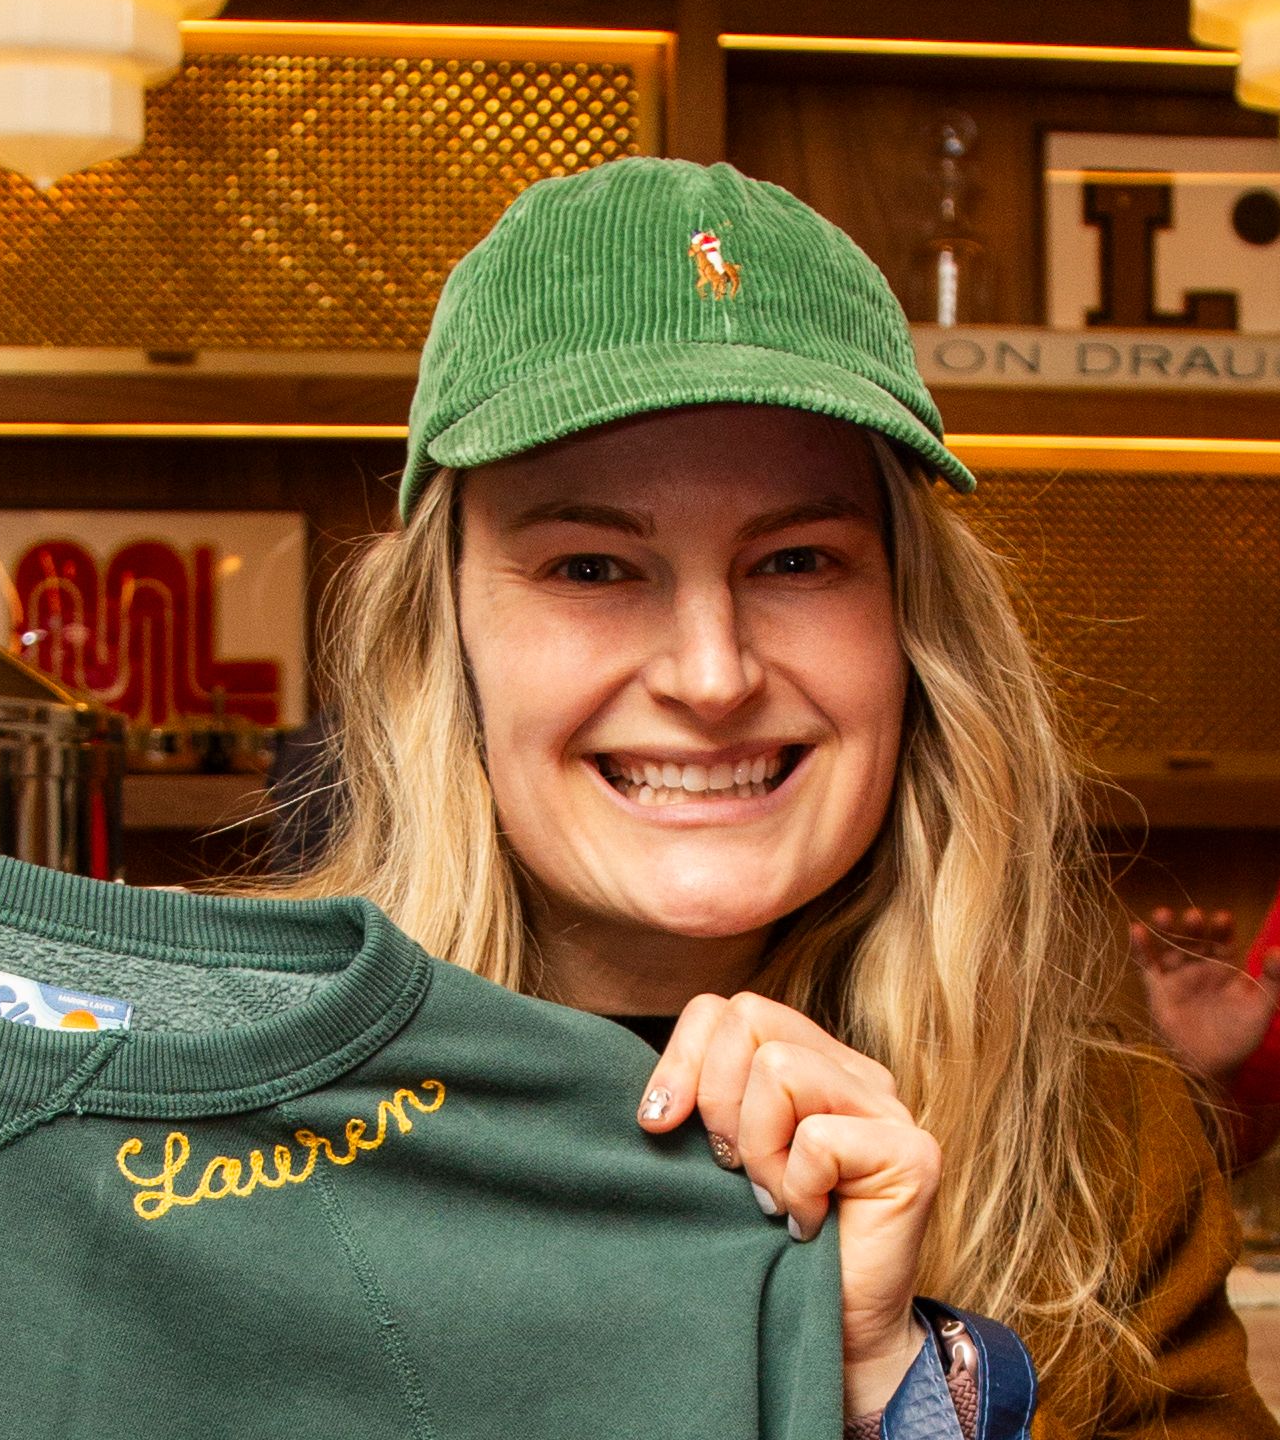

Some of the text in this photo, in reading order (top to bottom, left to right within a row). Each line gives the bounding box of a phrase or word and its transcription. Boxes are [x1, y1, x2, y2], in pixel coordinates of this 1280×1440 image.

[931, 339, 1042, 376] ON
[89, 1001, 116, 1013] LAYER
[116, 1079, 447, 1220] Lauren
